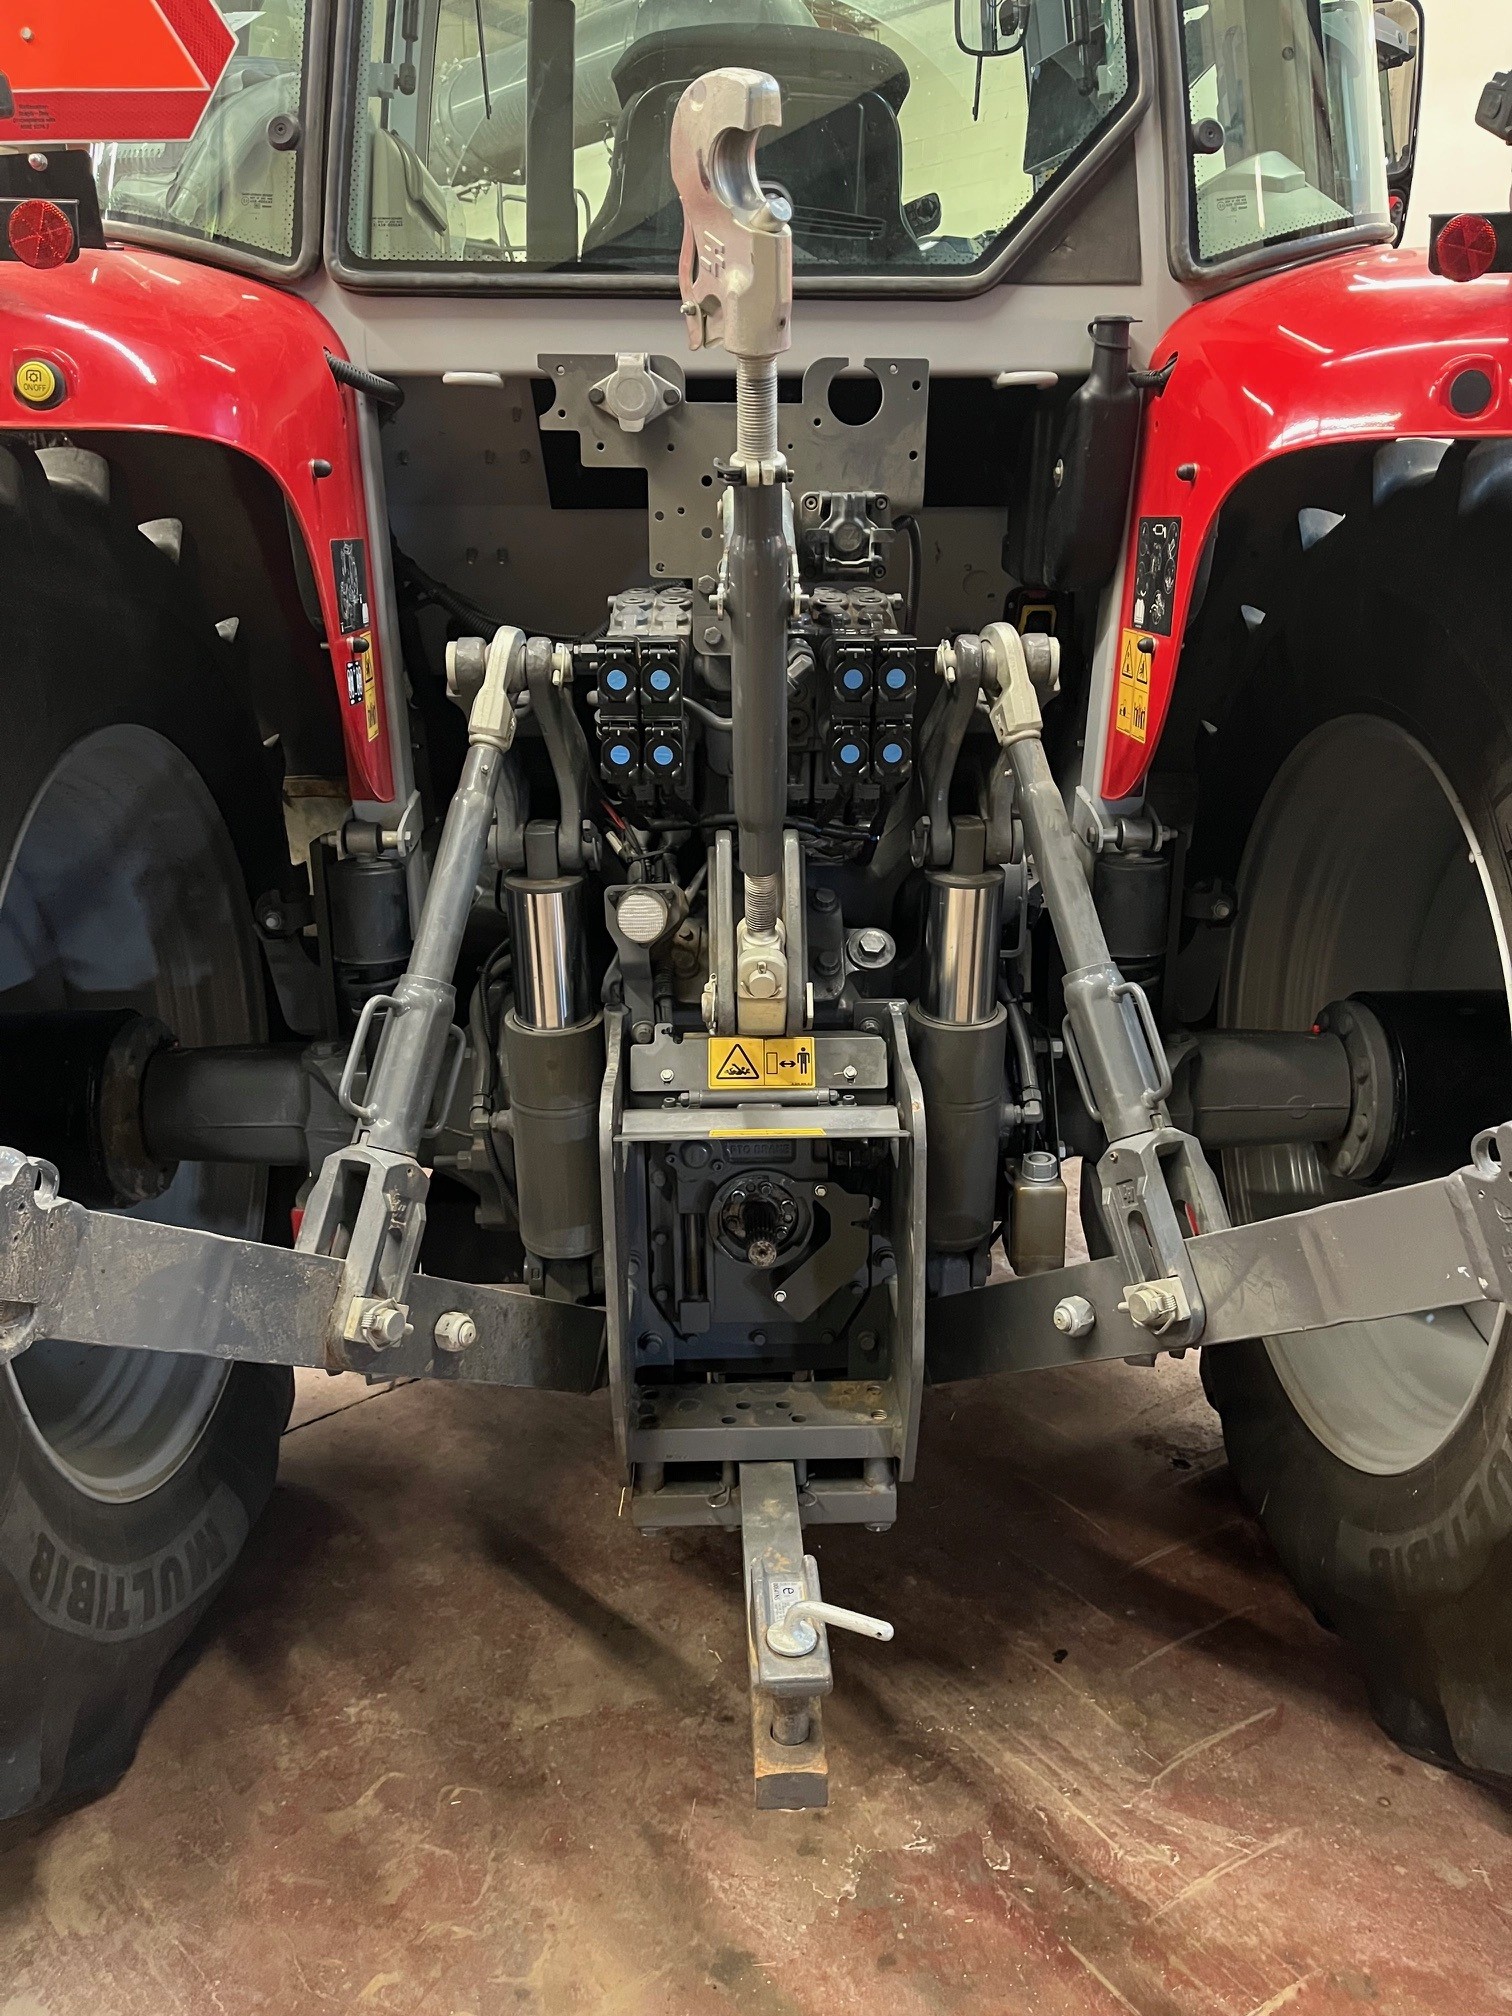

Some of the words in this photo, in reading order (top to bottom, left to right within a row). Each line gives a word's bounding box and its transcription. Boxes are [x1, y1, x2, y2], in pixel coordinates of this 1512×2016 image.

[24, 383, 46, 392] ON/OFF
[730, 1144, 750, 1154] PTO
[29, 1519, 228, 1630] MULTIBIB
